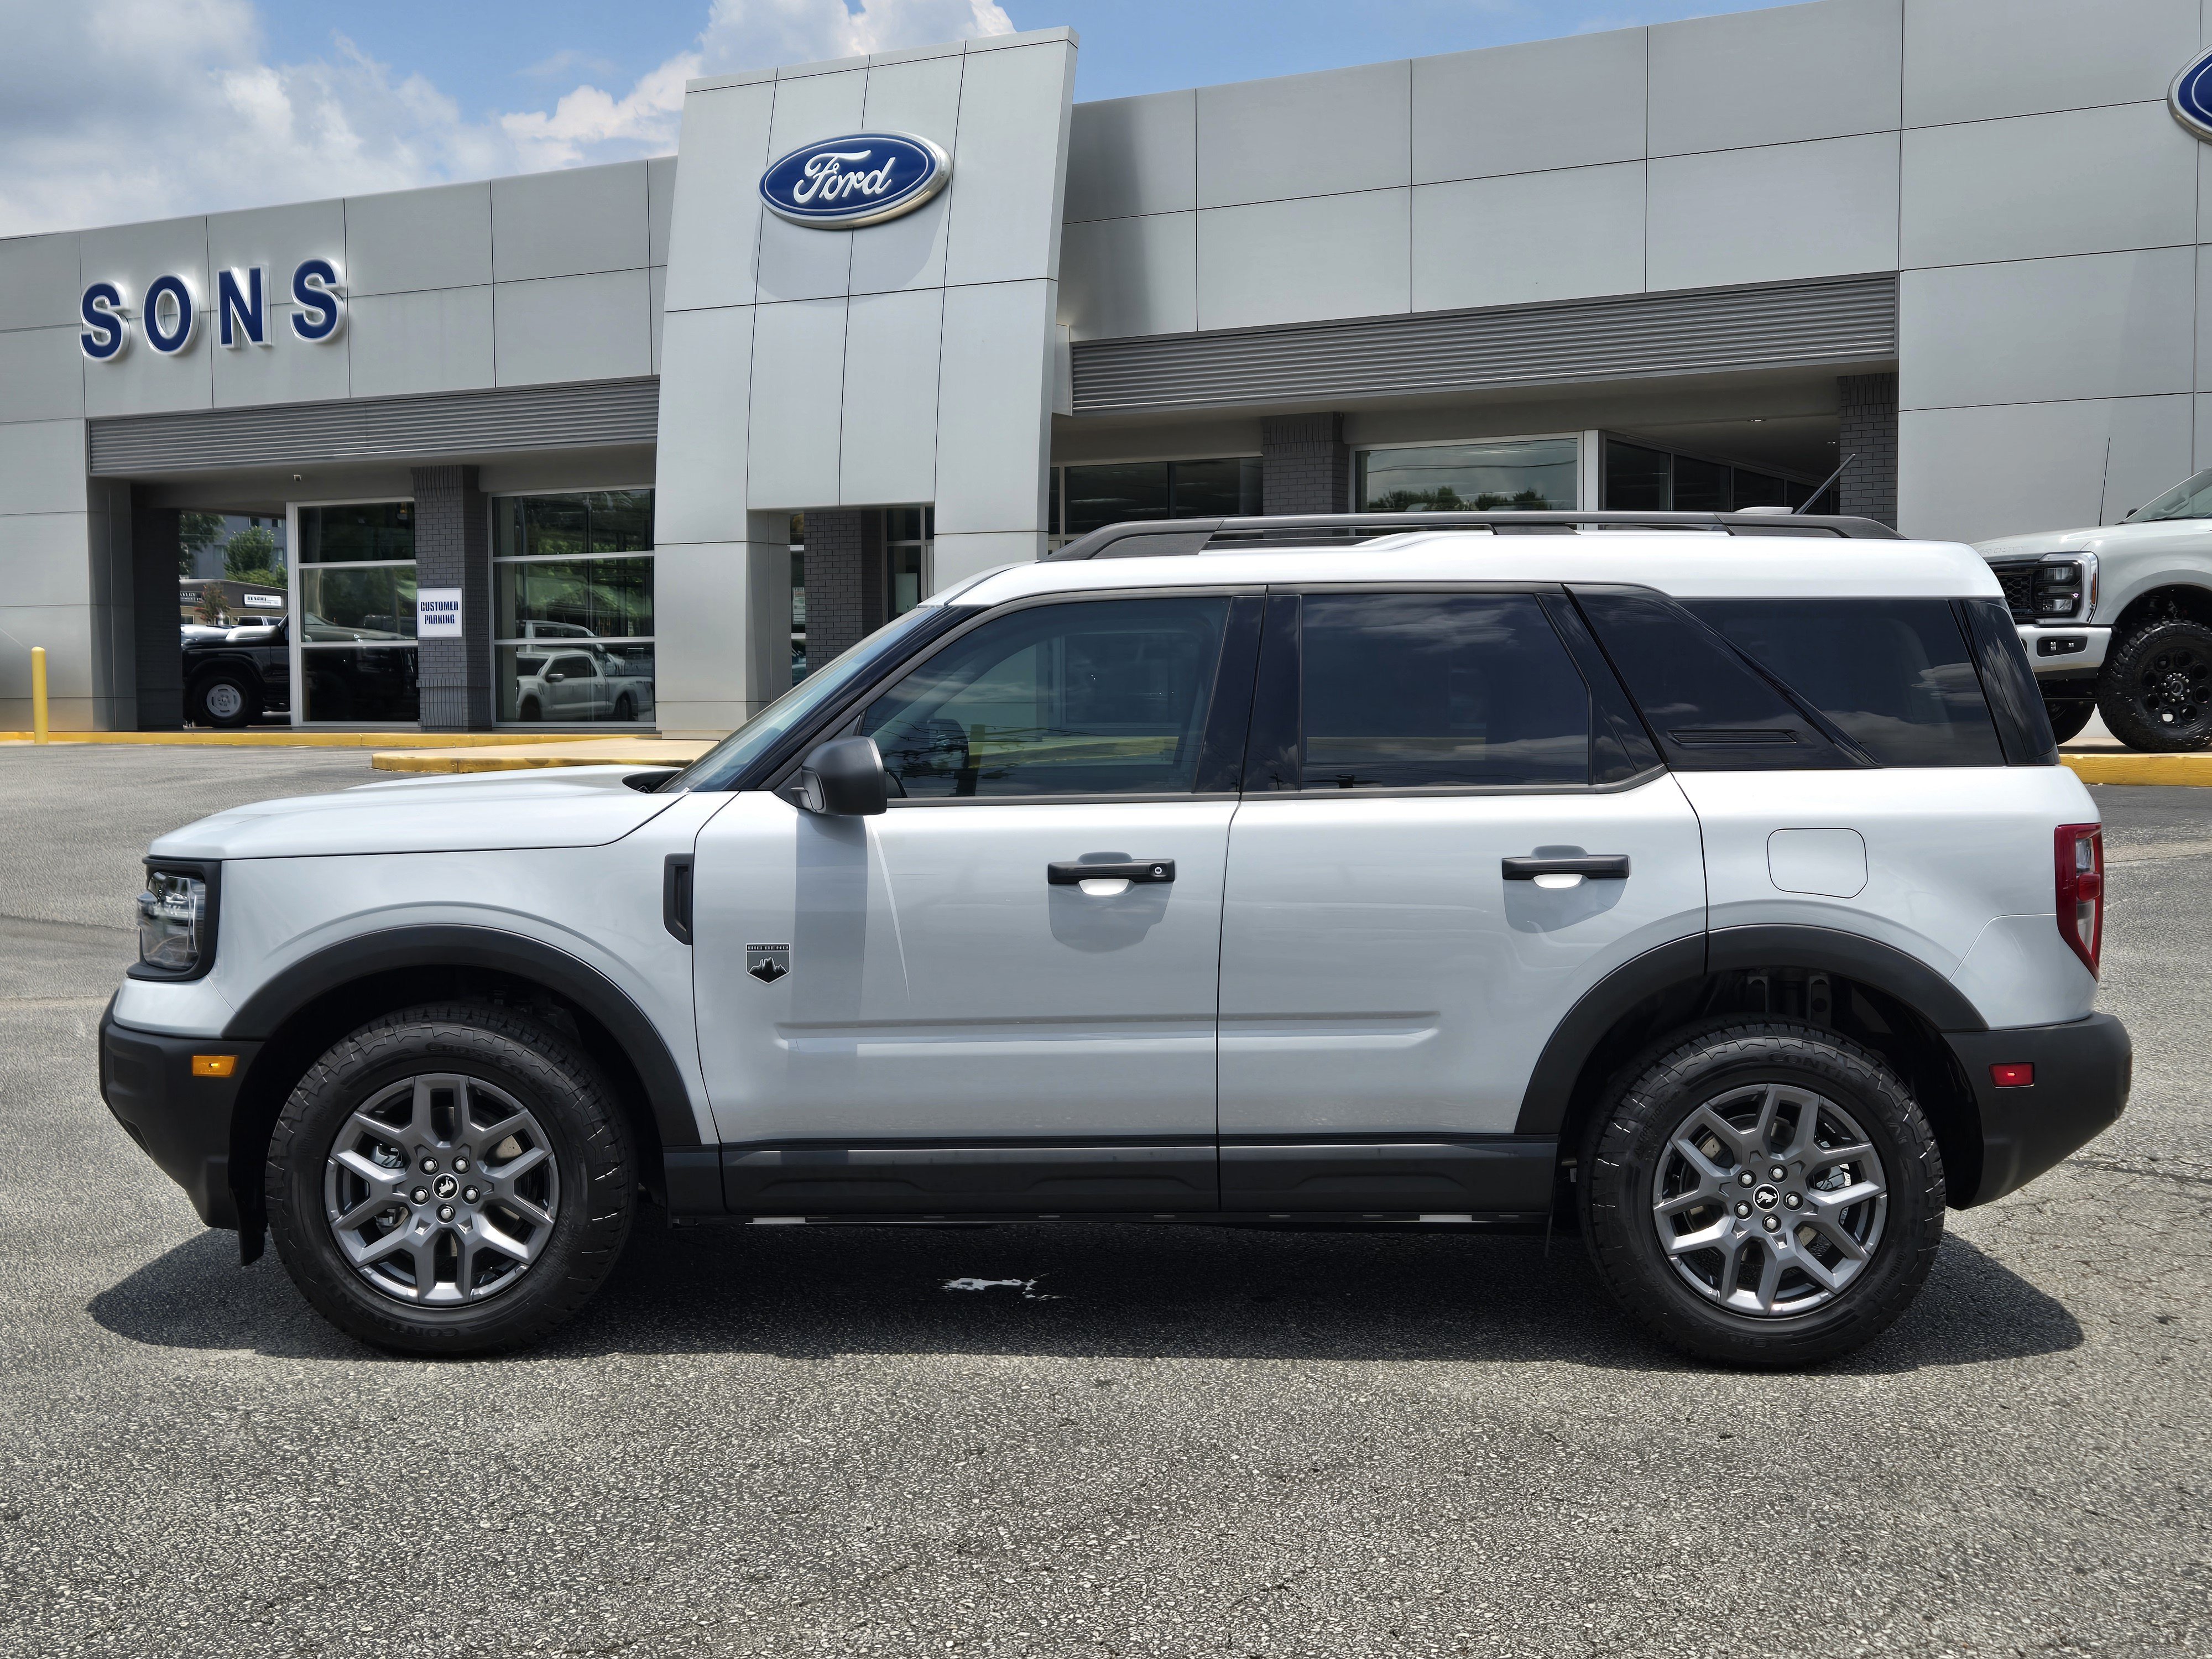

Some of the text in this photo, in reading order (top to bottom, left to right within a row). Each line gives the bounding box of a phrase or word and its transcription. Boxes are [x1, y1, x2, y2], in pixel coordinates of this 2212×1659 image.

[792, 149, 896, 204] Ford
[81, 258, 344, 361] SONS
[420, 601, 458, 611] CUSTOMER
[424, 614, 455, 624] PARKING
